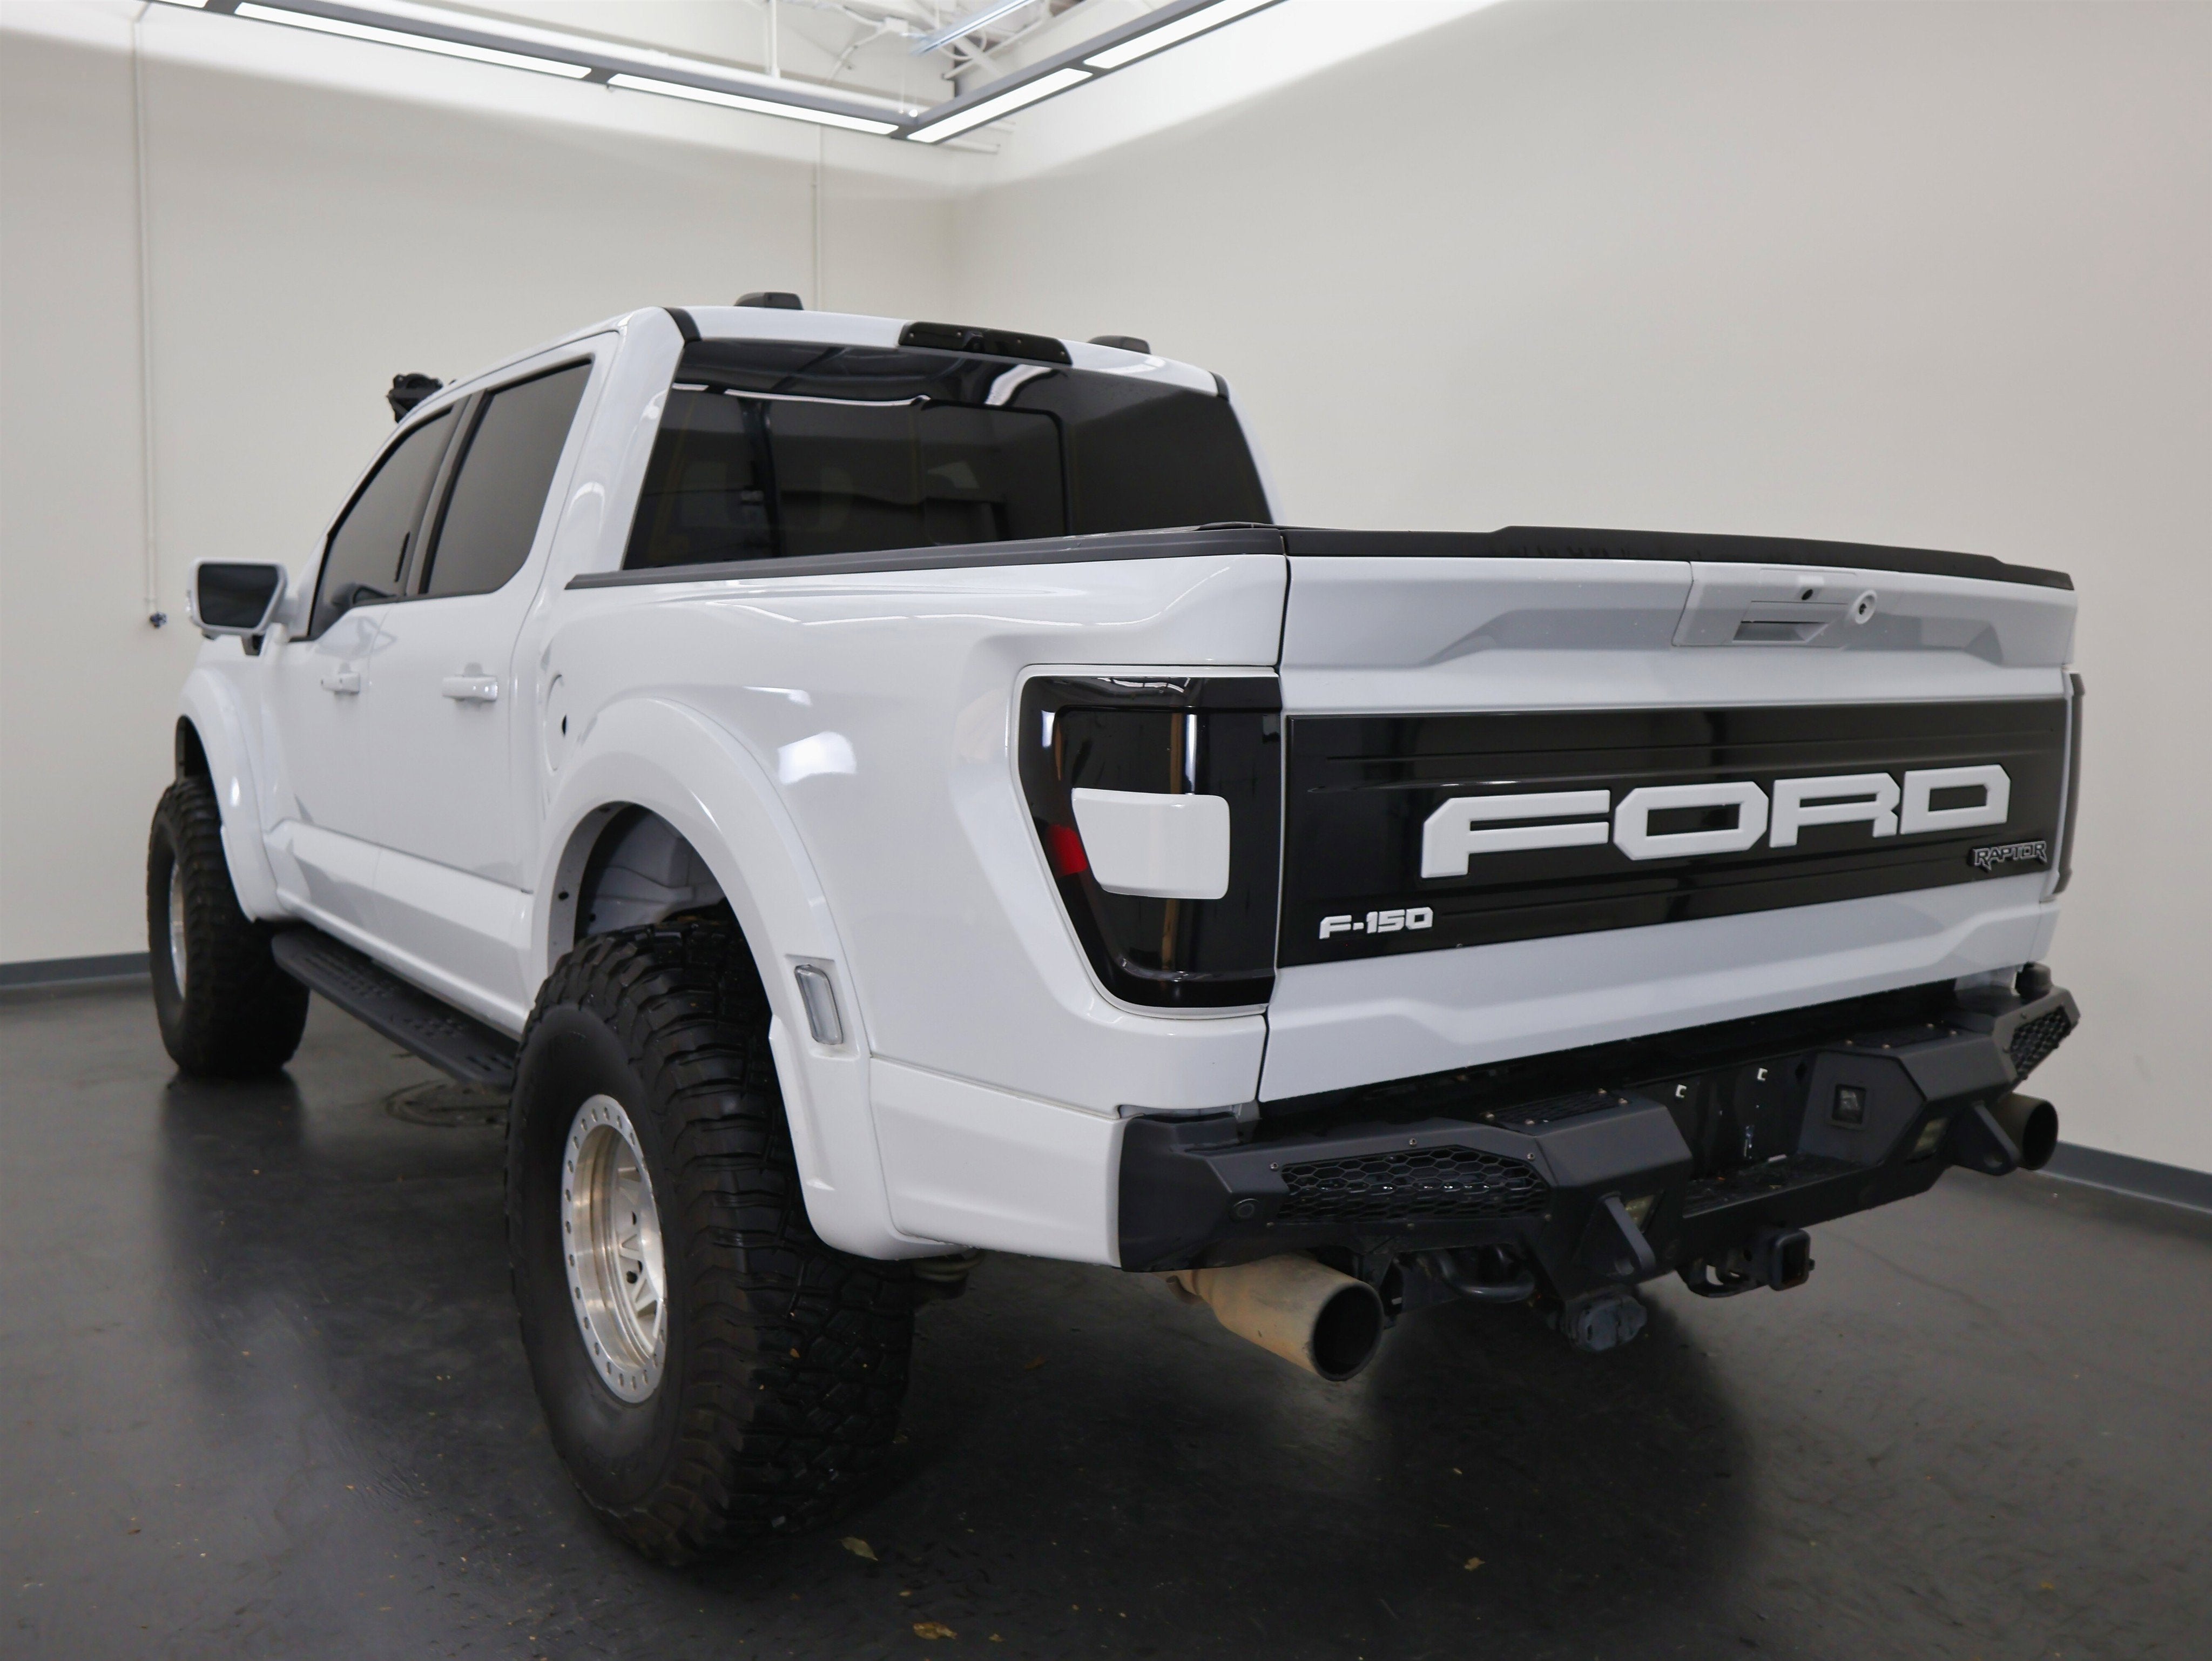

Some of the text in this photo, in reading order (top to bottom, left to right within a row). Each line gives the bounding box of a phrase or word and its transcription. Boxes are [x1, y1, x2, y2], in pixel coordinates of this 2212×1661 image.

[1421, 764, 2010, 877] FORD
[1972, 841, 2047, 871] RAPTOR
[1319, 907, 1433, 939] F-150
